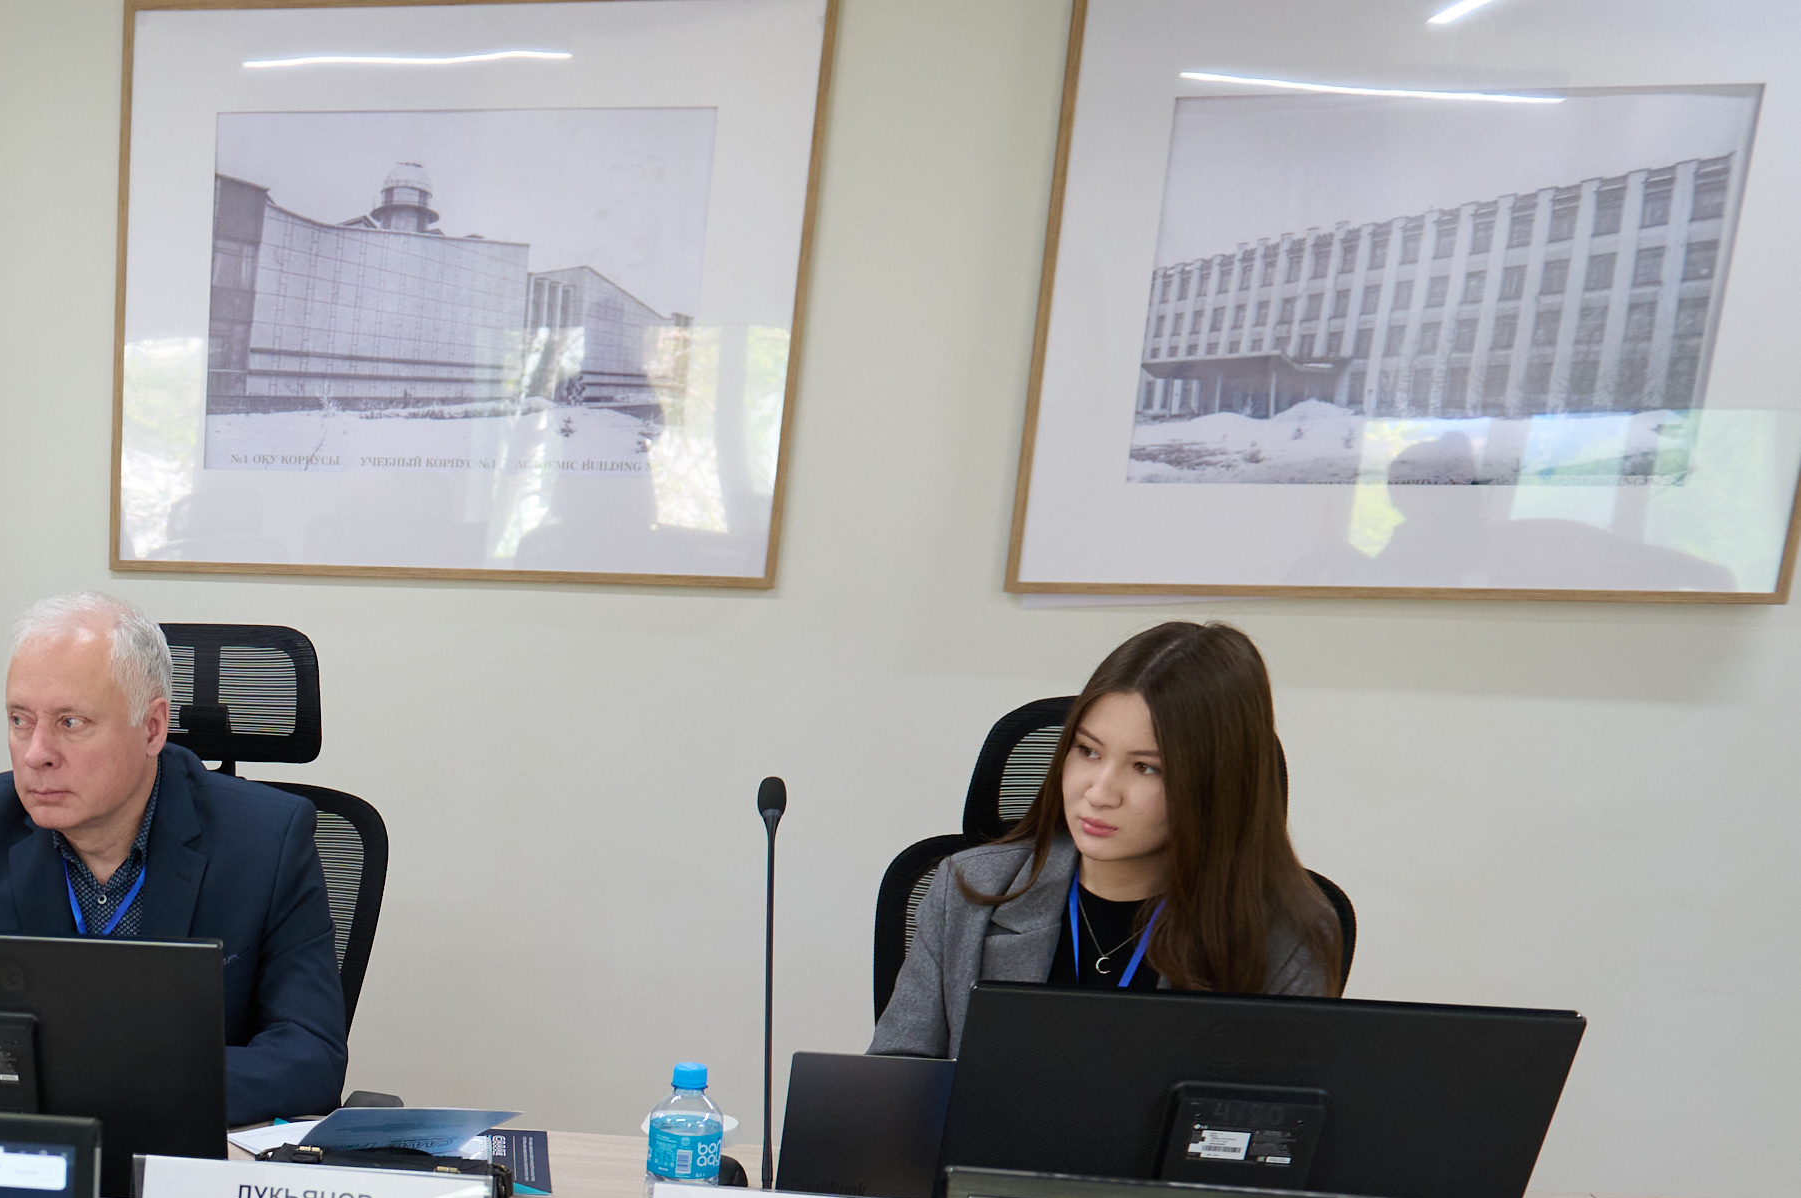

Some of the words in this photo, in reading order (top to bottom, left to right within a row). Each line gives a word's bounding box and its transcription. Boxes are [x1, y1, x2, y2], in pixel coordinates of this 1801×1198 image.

[360, 455, 422, 468] УЧЕБНЫЙ
[426, 457, 473, 469] КОРПУС
[582, 459, 642, 472] BUILDING
